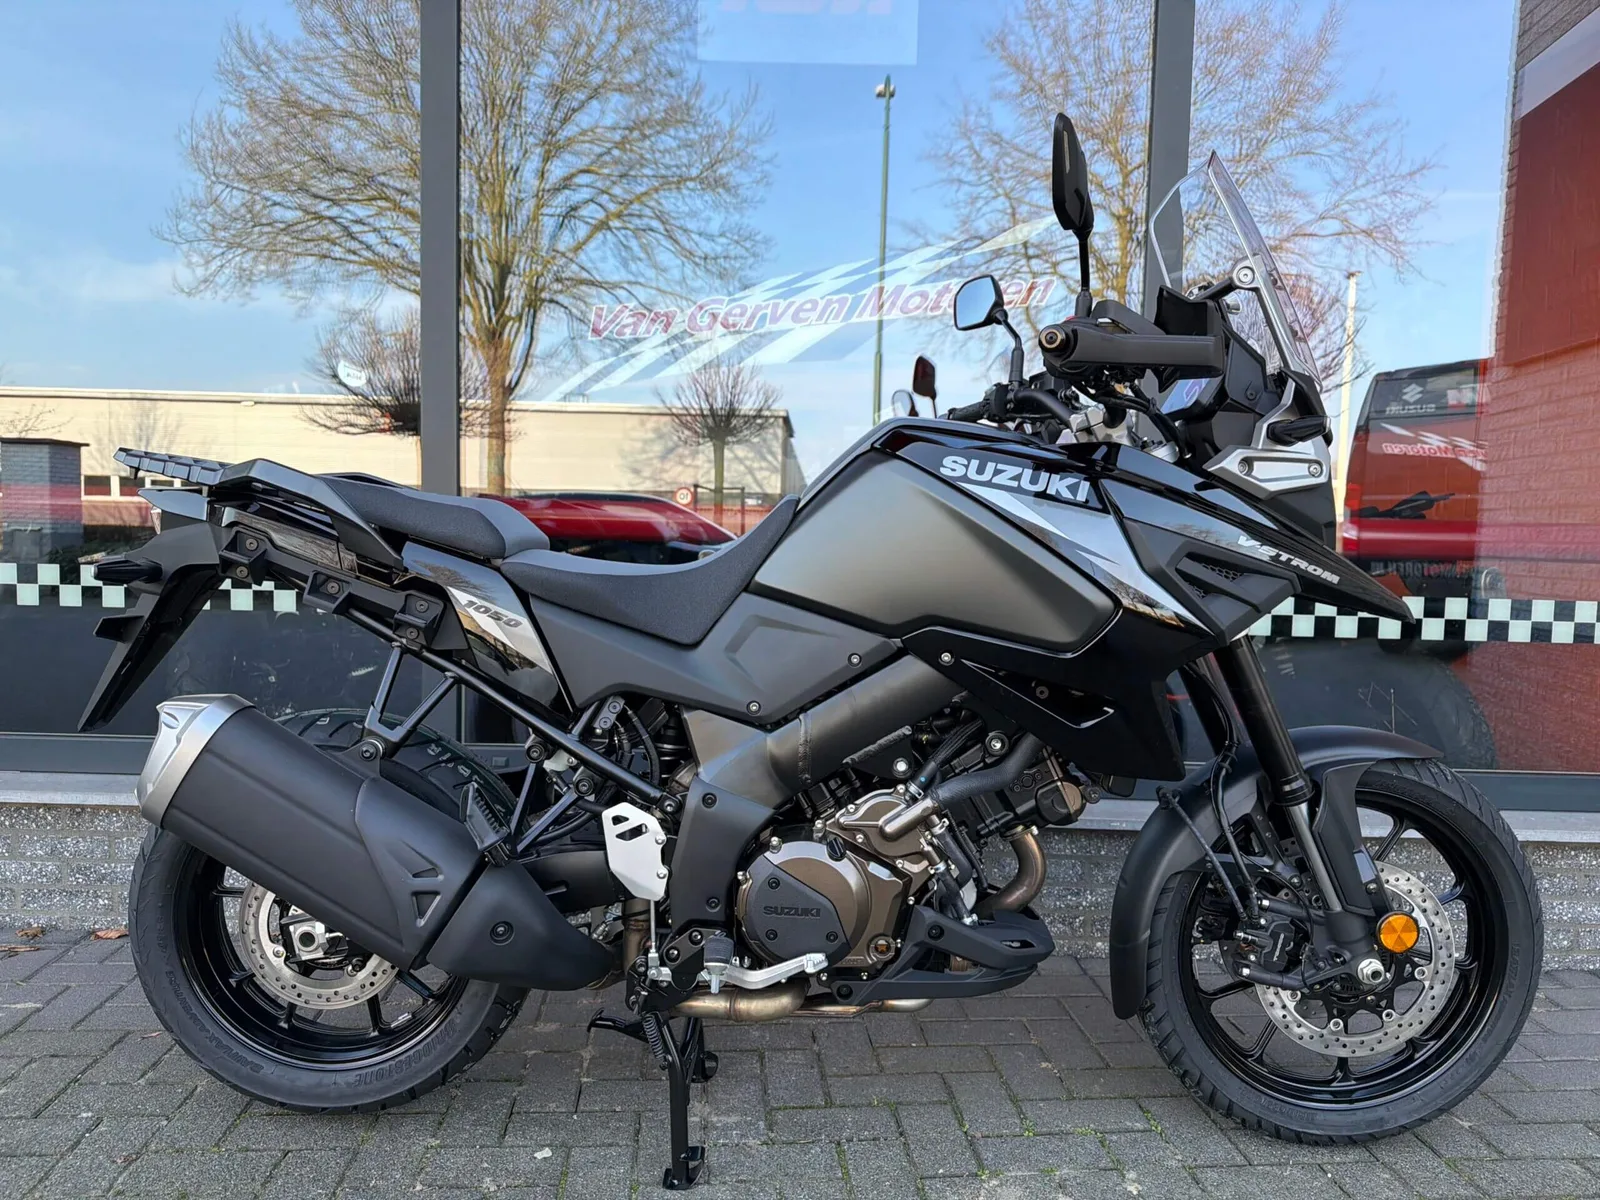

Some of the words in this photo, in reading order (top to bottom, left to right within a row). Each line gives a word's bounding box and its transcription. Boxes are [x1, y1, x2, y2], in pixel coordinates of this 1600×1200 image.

[589, 303, 678, 340] Van
[685, 294, 853, 335] Gerven
[851, 277, 1056, 319] Moten
[939, 455, 1091, 502] SUZUKI
[1237, 535, 1340, 585] V-STROM
[463, 600, 523, 628] 1050
[763, 905, 821, 918] SUZUKI
